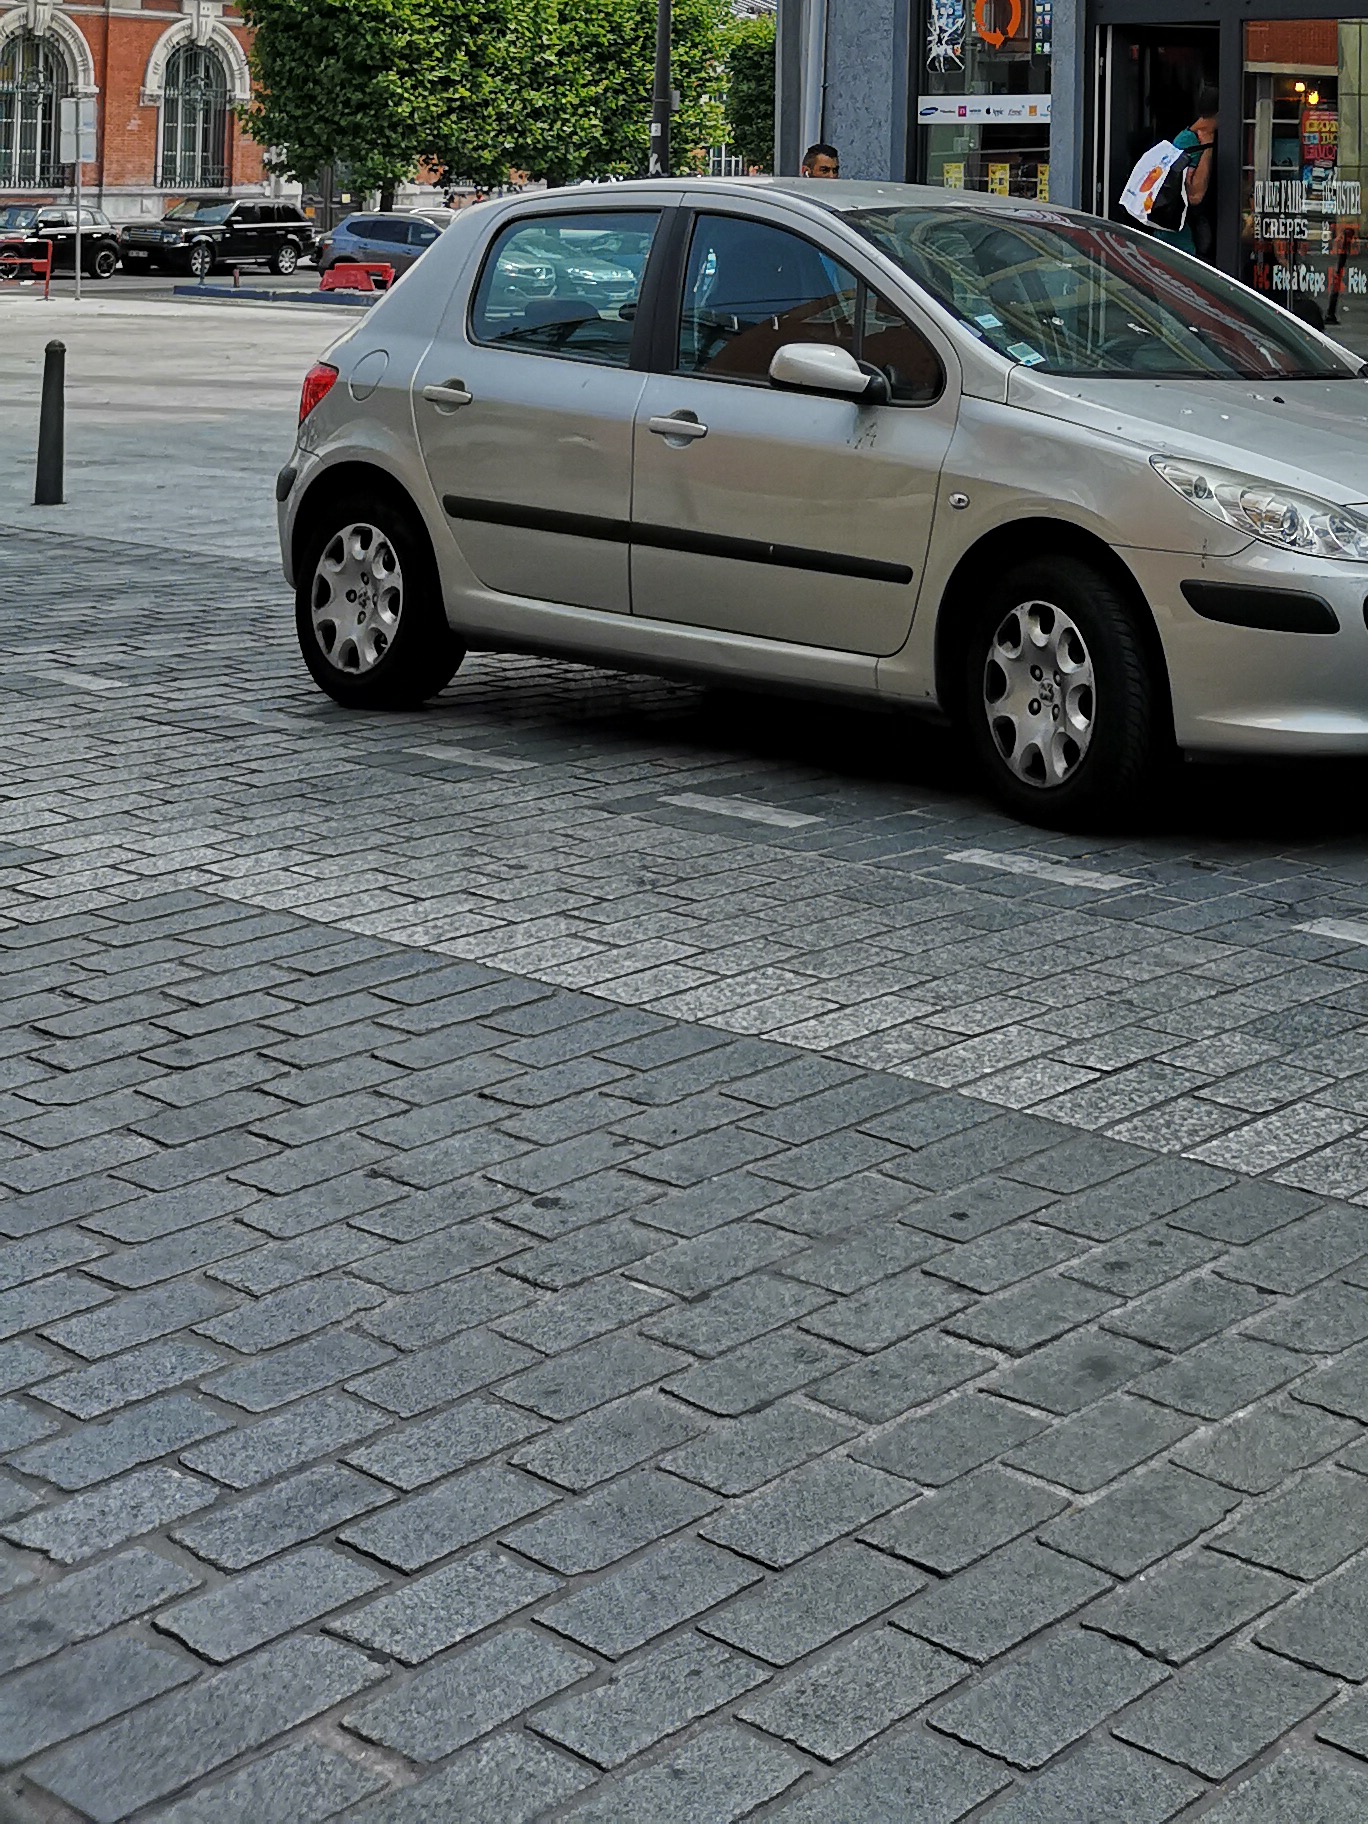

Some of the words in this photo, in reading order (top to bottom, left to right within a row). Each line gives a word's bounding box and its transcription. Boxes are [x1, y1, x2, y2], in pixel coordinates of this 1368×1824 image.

[1263, 214, 1309, 240] CRÊPES
[1272, 264, 1291, 291] Fête
[1299, 263, 1326, 297] Crêpe
[1348, 267, 1367, 294] Fête
